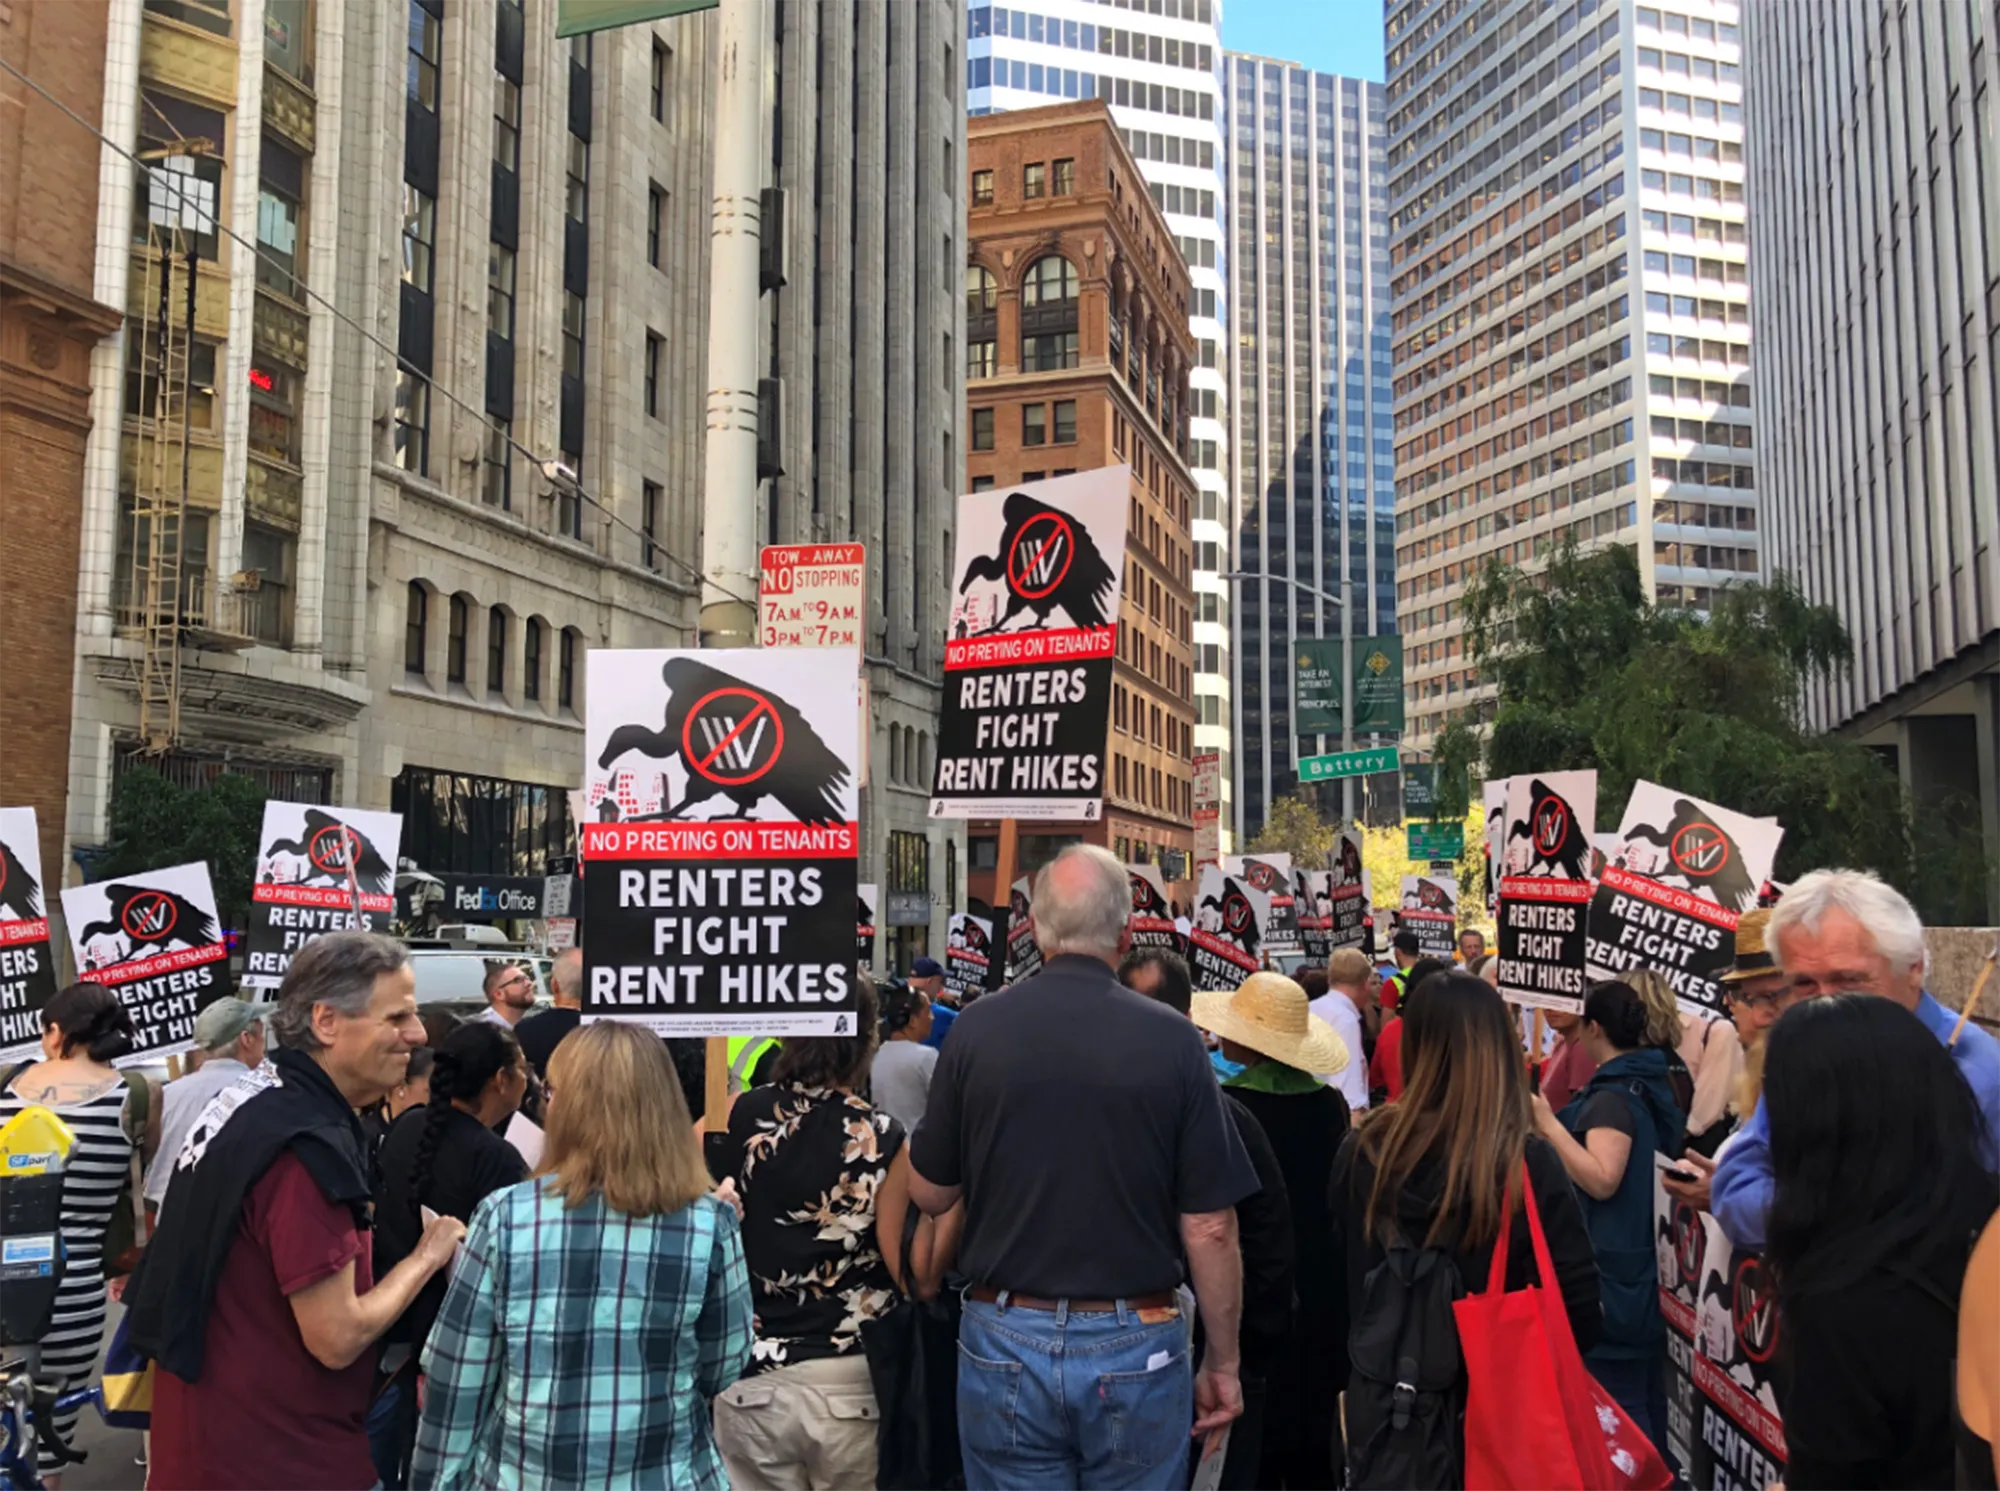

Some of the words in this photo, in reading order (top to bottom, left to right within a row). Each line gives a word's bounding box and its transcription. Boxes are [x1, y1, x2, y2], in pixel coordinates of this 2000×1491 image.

[763, 567, 792, 592] NO
[796, 568, 860, 588] STOPPING
[949, 646, 966, 664] NO
[967, 640, 1021, 663] PREYING
[1025, 638, 1044, 656] ON
[1049, 631, 1110, 655] TENANTS
[960, 667, 1087, 710] RENTERS
[976, 712, 1060, 749] FIGHT
[938, 757, 1004, 790] RENT
[1011, 754, 1098, 790] HIKES
[1310, 755, 1385, 775] Battery
[590, 831, 620, 851] NO
[626, 830, 718, 851] PREYING
[722, 830, 752, 851] ON
[758, 828, 852, 850] TENANTS
[257, 888, 273, 898] NO
[275, 889, 322, 902] PREYING
[325, 893, 339, 904] ON
[456, 886, 498, 911] FedEx
[499, 888, 536, 911] Office
[619, 867, 823, 907] RENTERS
[1604, 871, 1623, 884] NO
[1623, 875, 1673, 901] PREYING
[1674, 895, 1690, 909] ON
[5, 922, 46, 940] TENANTS
[1508, 904, 1576, 932] RENTERS
[1609, 894, 1722, 951] RENTERS
[654, 916, 788, 956] FIGHT
[1131, 931, 1174, 947] ENTERS
[1518, 933, 1564, 960] FIGHT
[1619, 924, 1696, 967] FIGHT
[103, 963, 154, 983] PREYING
[155, 958, 171, 969] ON
[173, 946, 223, 965] TENANTS
[249, 952, 293, 972] REN
[1585, 937, 1643, 970] RENT
[590, 965, 704, 1005] RENT
[720, 963, 848, 1004] HIKES
[1499, 958, 1535, 986] RENT
[1537, 963, 1582, 994] HIKES
[128, 992, 198, 1024] FIGHT
[1702, 1404, 1783, 1491] RENTER
